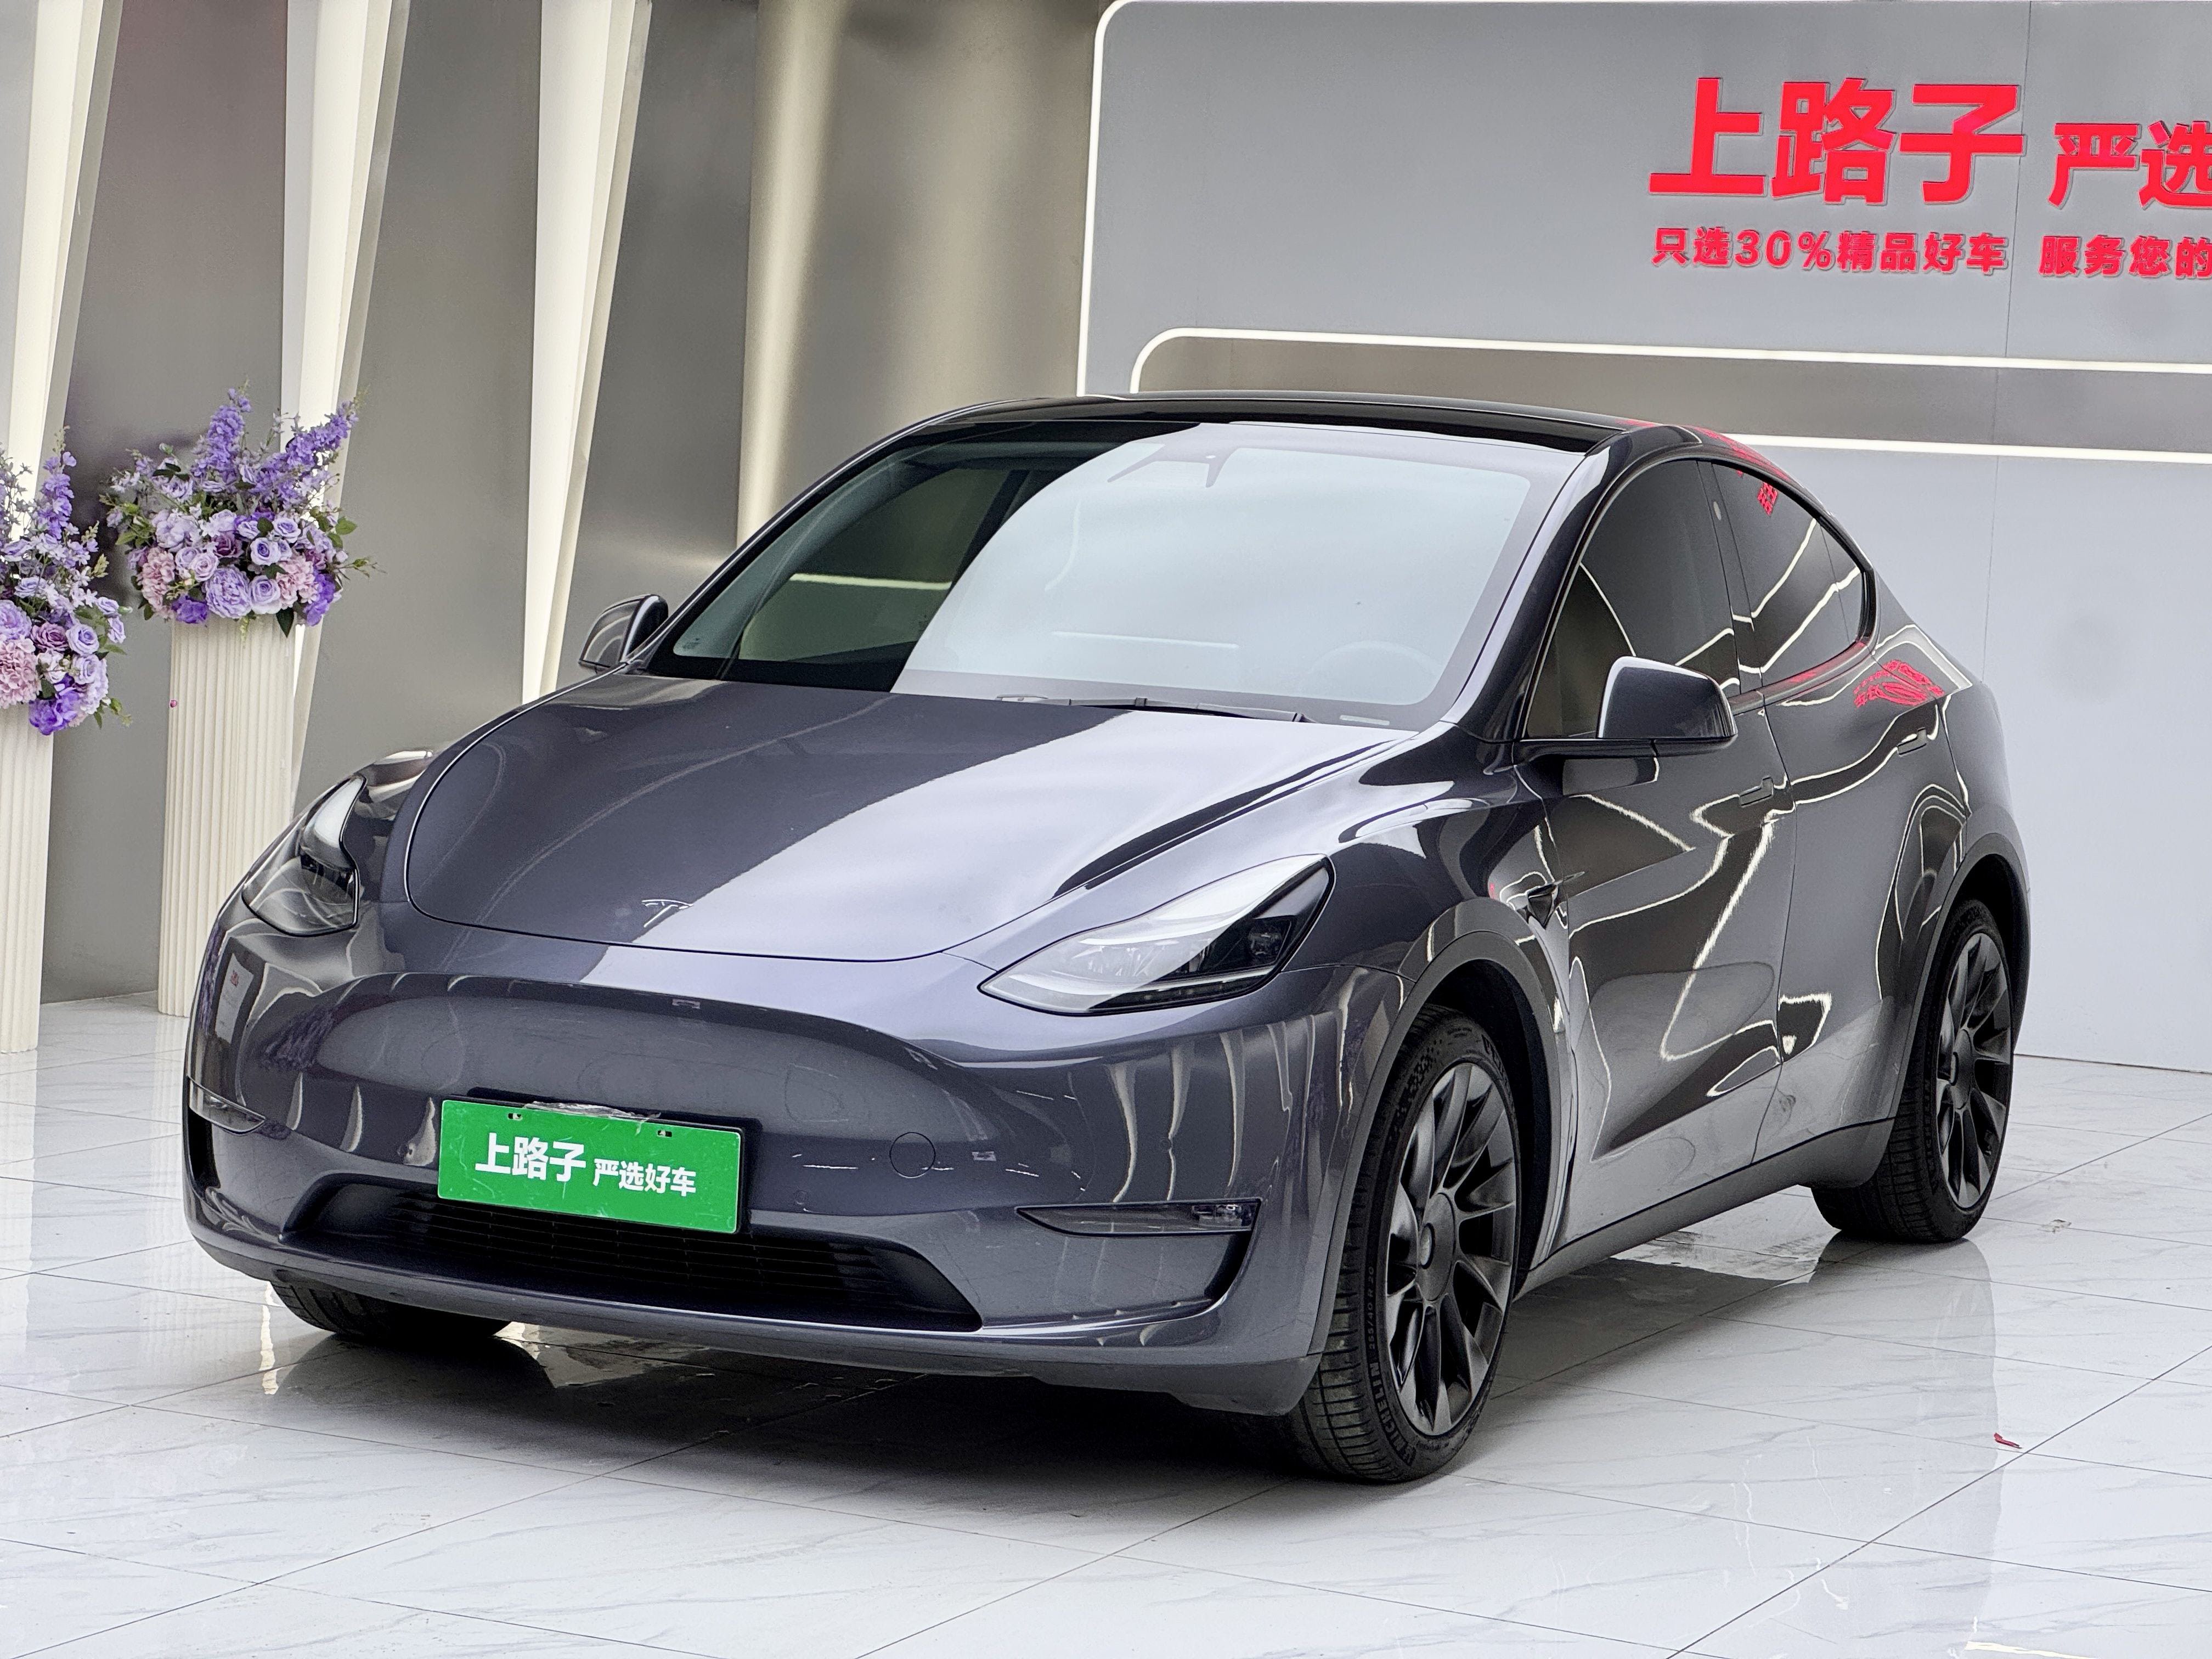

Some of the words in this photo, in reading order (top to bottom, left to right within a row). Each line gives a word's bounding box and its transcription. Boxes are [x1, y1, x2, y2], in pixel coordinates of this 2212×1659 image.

[1647, 77, 2025, 205] 上路子
[2047, 120, 2212, 208] 严选
[1651, 226, 2007, 274] 只选30%精品好车
[2038, 234, 2212, 279] 服务您的
[475, 1132, 586, 1182] 上路子
[593, 1158, 697, 1197] 严选好车
[1367, 1266, 1375, 1284] 20
[1369, 1362, 1407, 1452] MICHELIN
